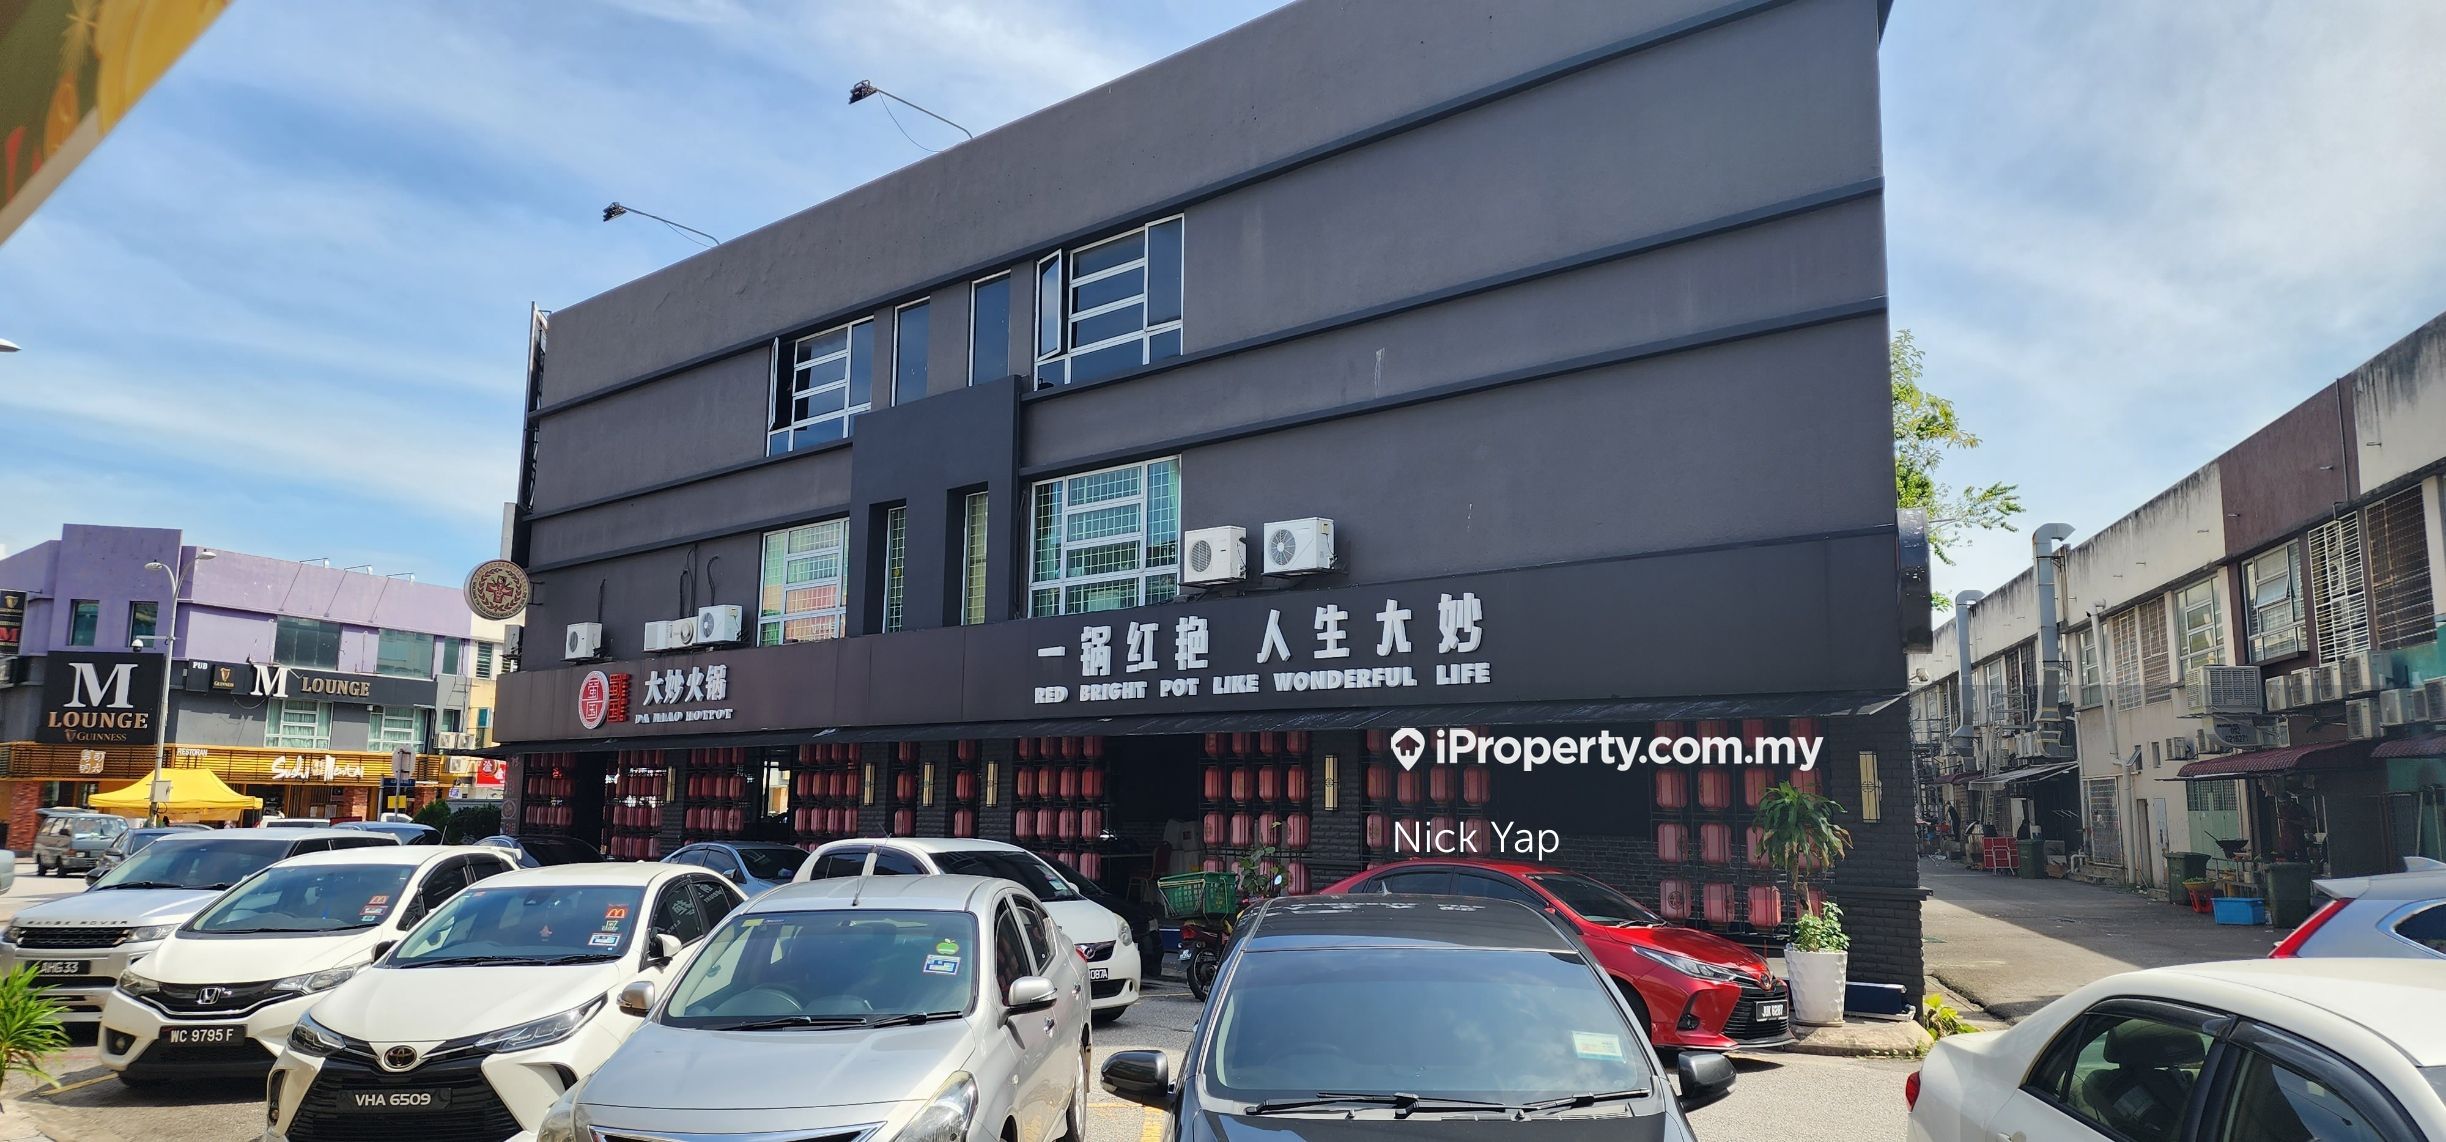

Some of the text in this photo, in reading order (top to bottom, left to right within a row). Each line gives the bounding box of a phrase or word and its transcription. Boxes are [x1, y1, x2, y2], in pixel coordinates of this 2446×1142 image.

[1037, 592, 1483, 677] 一锅红艳 人生大妙
[192, 661, 208, 670] PUB
[63, 662, 138, 708] M
[250, 664, 371, 698] M LOUNGE
[643, 664, 728, 706] 大妙火锅
[1034, 662, 1491, 704] RED BRIGHT POT LIKE WONDERFUL LIFE
[47, 711, 149, 729] LOUNGE
[685, 708, 733, 722] HOTPOT
[76, 731, 127, 741] GUINNESS
[176, 747, 208, 757] RESTORAN
[170, 1028, 234, 1042] WC 9795 F
[355, 1093, 431, 1106] VHA 6509
